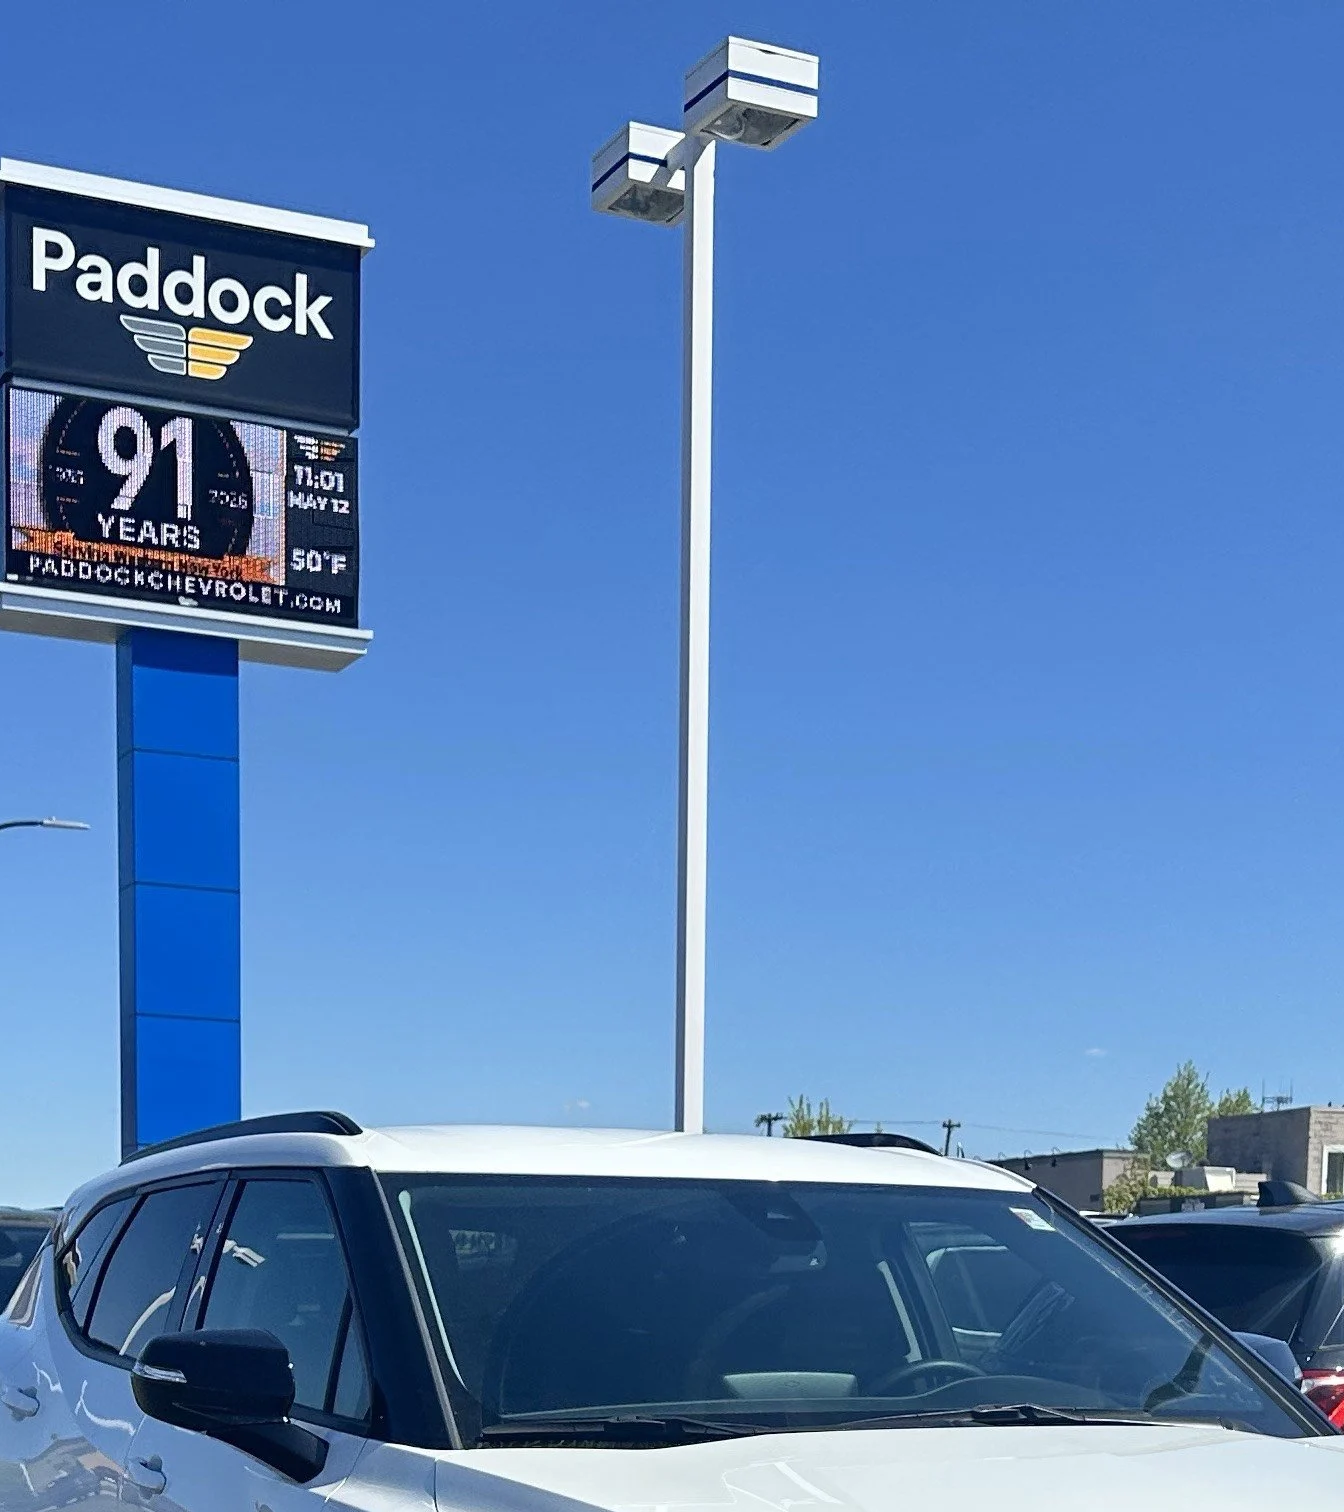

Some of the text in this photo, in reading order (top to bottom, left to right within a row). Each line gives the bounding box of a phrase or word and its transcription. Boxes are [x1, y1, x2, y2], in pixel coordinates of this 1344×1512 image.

[31, 226, 335, 340] Paddock
[97, 406, 194, 520] 91
[293, 464, 345, 493] 11:01
[97, 512, 201, 550] YEARS
[29, 553, 342, 615] PADDOCKCHEVROLET.COM
